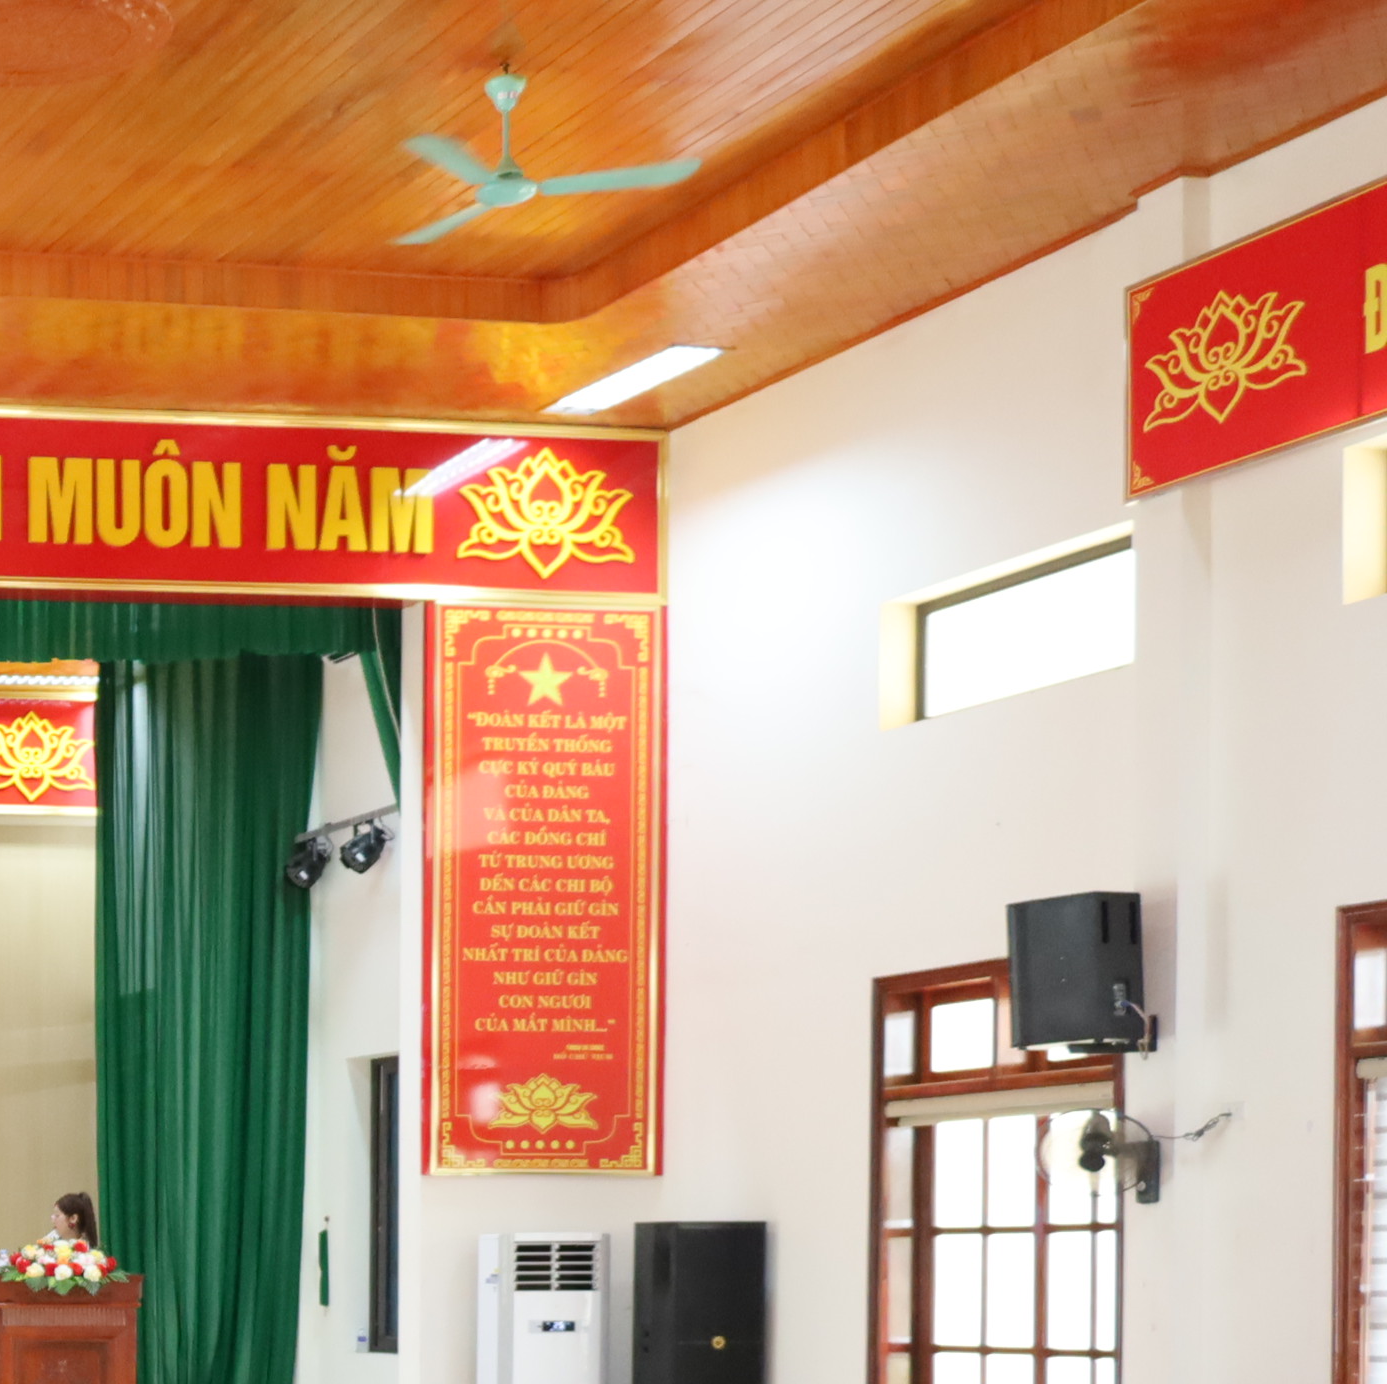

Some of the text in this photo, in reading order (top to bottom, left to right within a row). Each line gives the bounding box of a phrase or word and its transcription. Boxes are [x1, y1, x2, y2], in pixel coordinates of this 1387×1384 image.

[28, 439, 242, 548] MUÔN
[265, 446, 435, 553] NĂM
[505, 854, 562, 868] TRUNG
[555, 879, 585, 892] CHI
[499, 995, 533, 1007] CON
